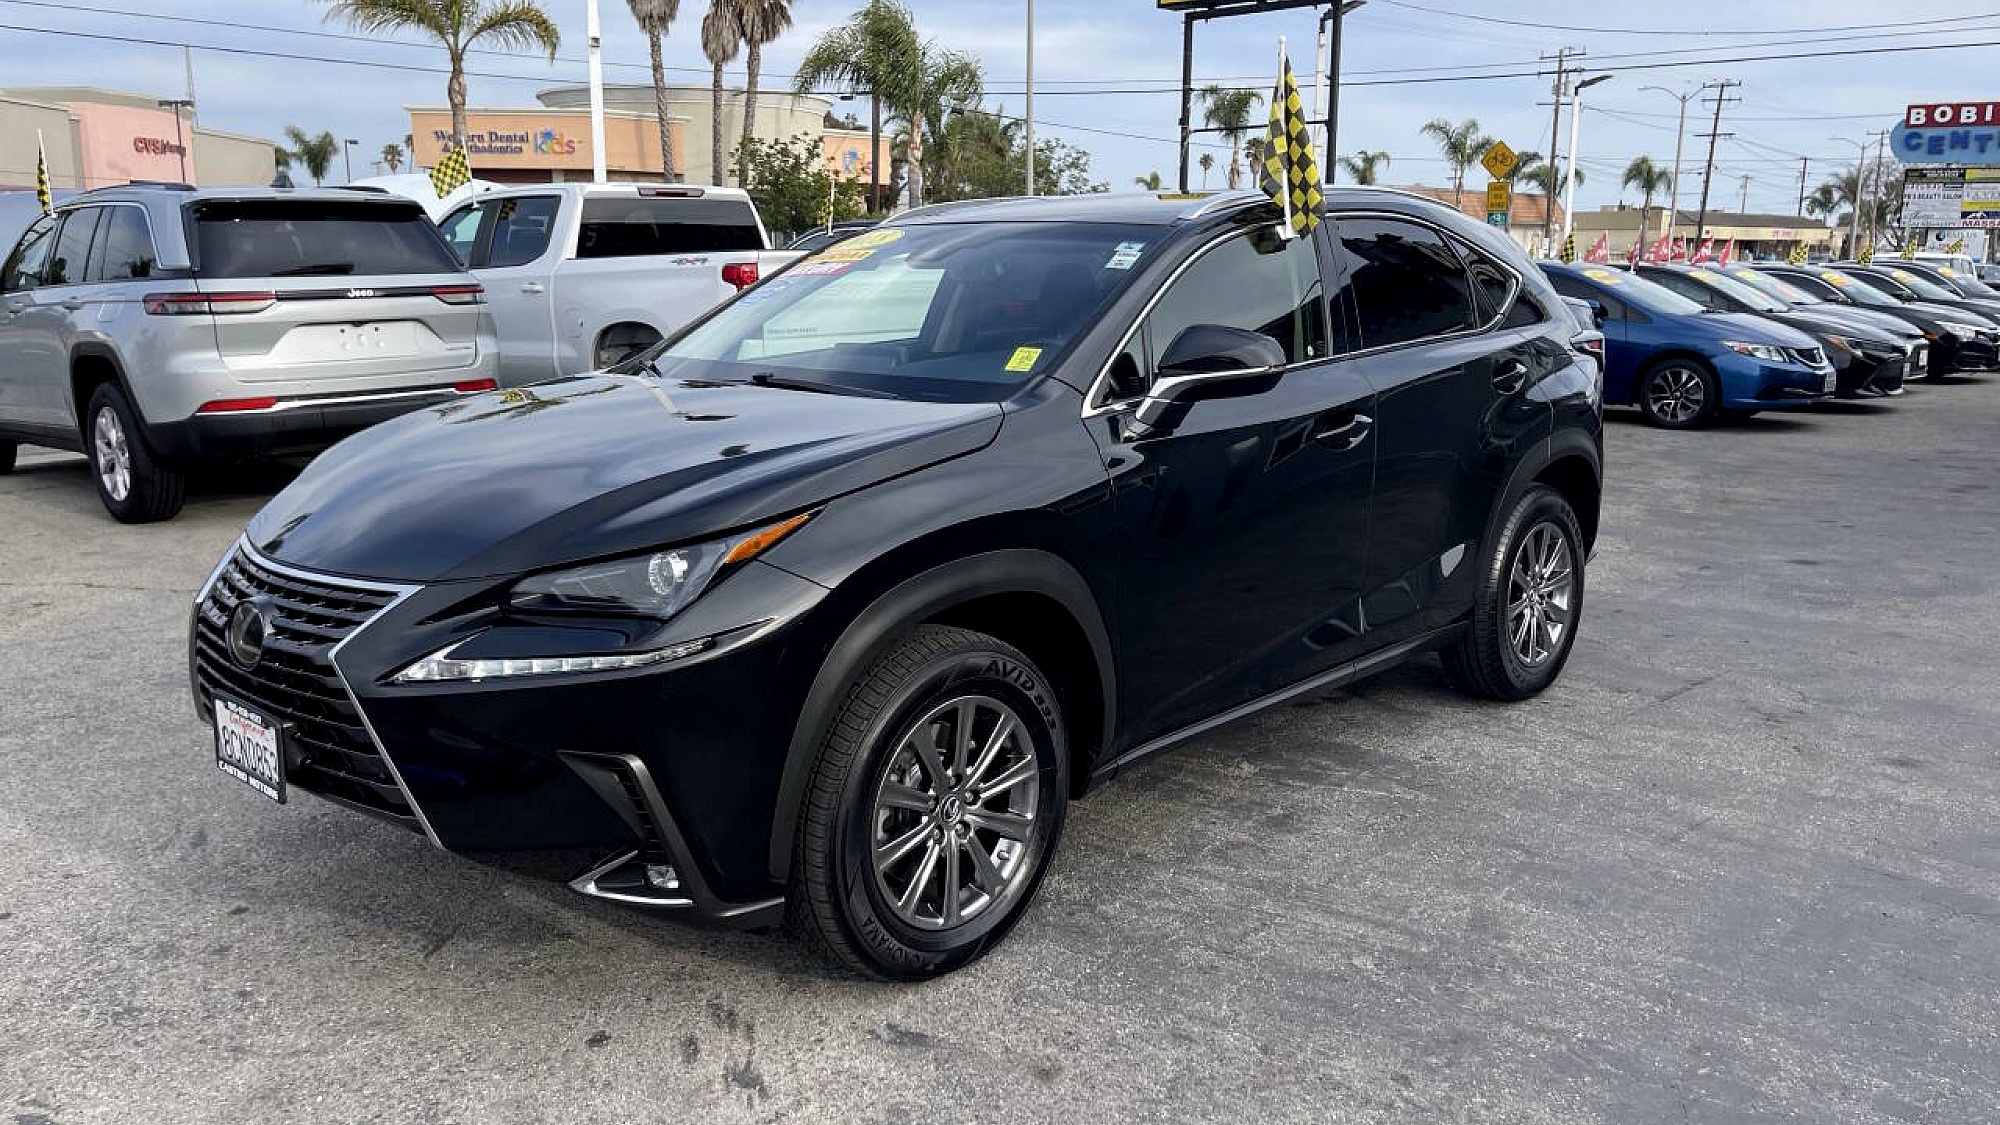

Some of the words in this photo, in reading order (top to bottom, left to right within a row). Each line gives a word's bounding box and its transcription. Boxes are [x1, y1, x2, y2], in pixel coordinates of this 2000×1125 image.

[434, 130, 485, 142] Weern
[488, 131, 529, 144] Dental
[1904, 130, 2000, 156] CENT
[347, 287, 375, 299] Jeep
[987, 659, 1036, 692] AVID
